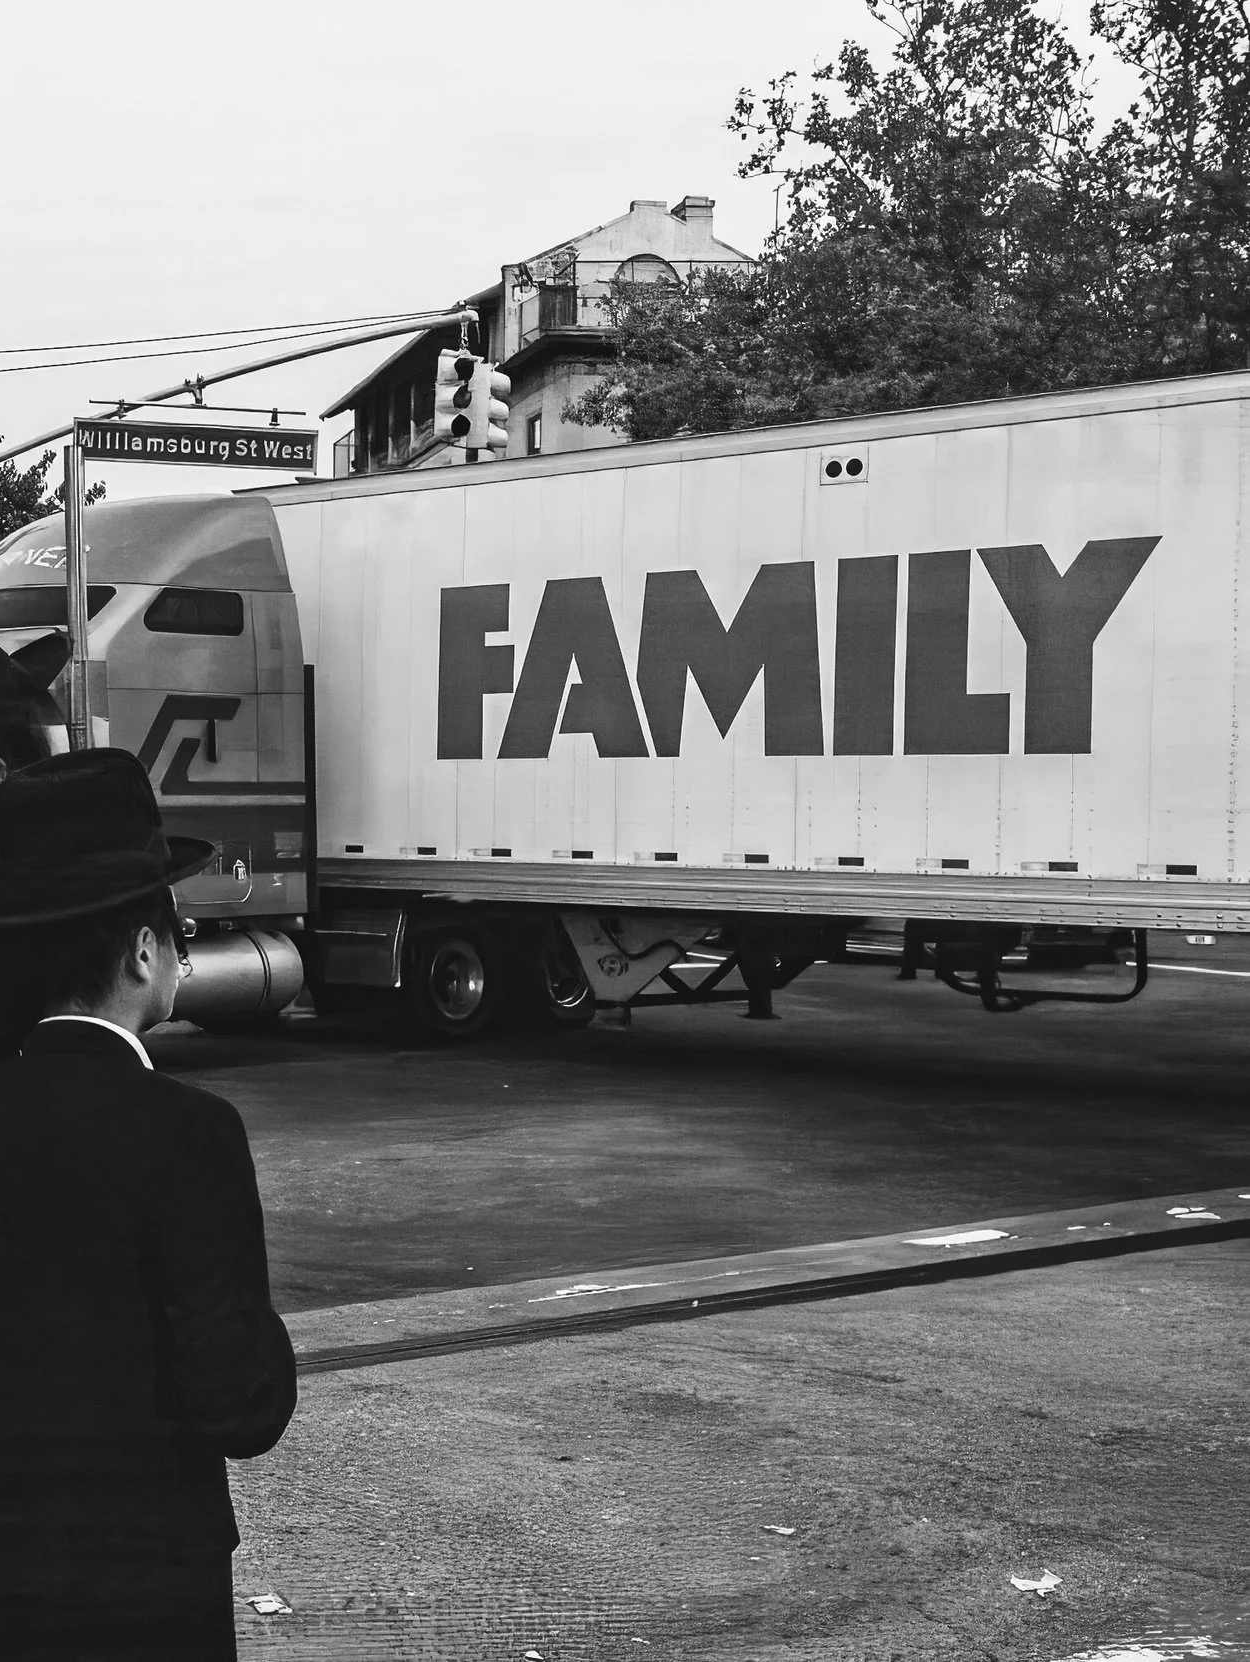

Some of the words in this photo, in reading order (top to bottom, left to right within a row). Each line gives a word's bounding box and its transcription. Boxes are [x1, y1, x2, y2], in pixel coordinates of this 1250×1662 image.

[79, 429, 230, 461] Williamsburg
[235, 438, 258, 457] St
[263, 439, 313, 460] West
[437, 536, 1162, 760] FAMILY
